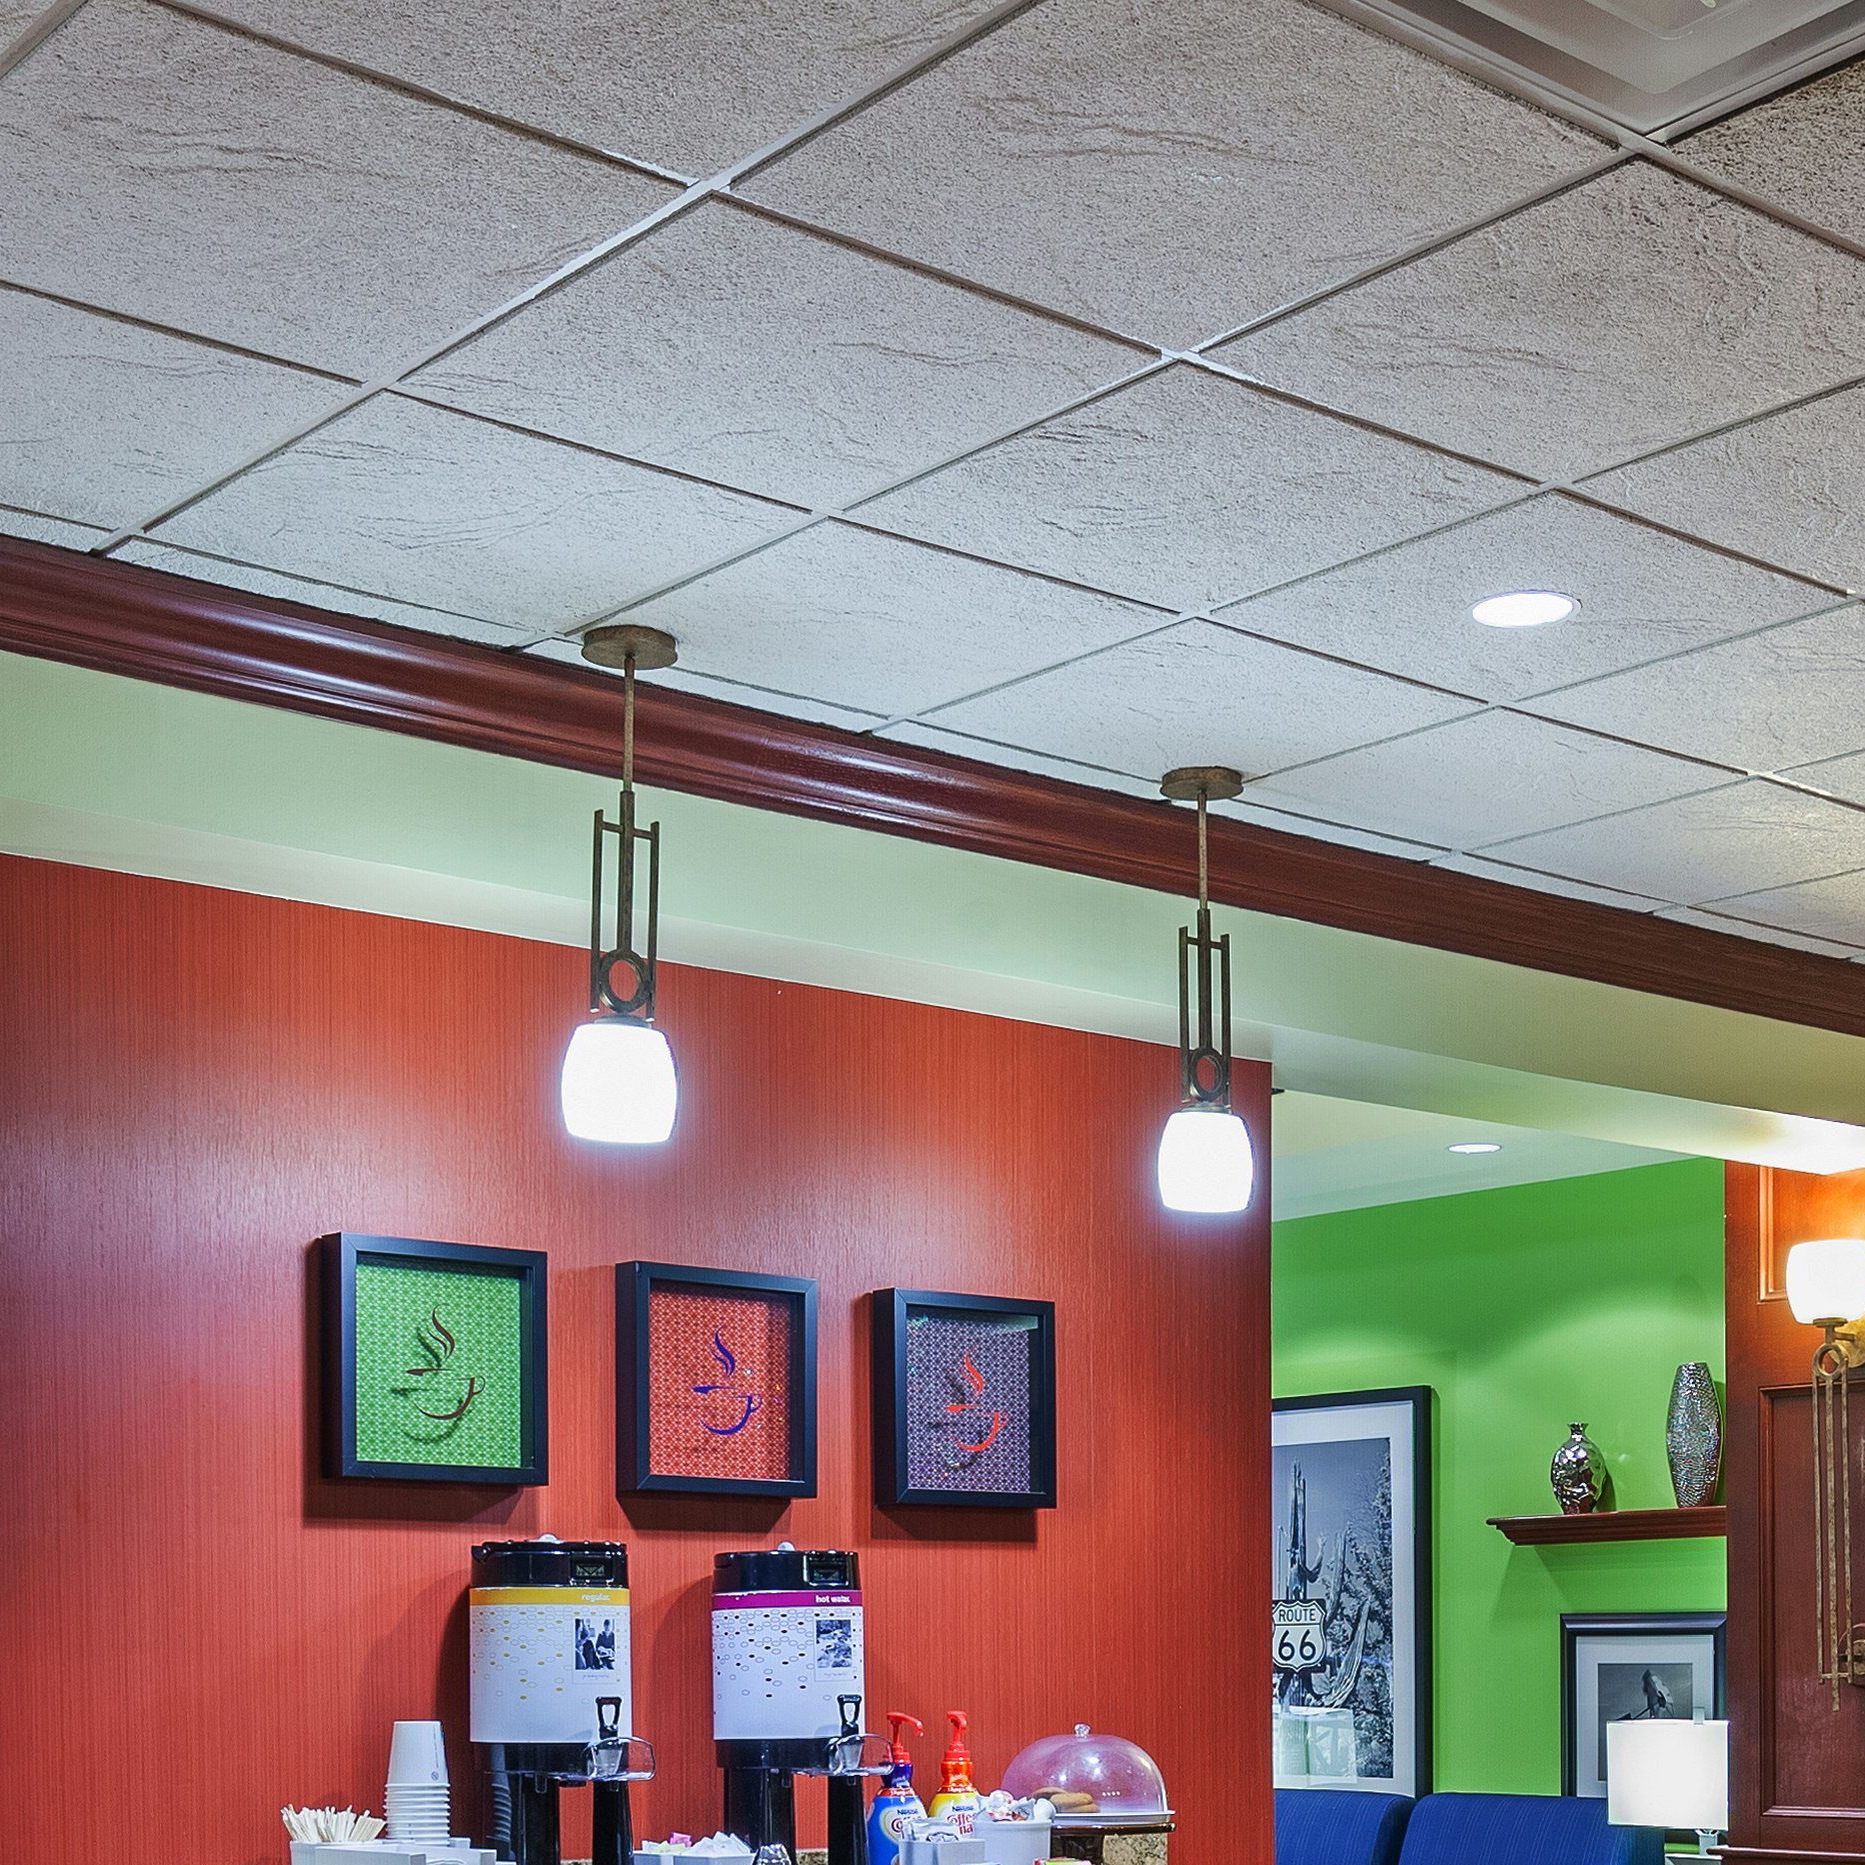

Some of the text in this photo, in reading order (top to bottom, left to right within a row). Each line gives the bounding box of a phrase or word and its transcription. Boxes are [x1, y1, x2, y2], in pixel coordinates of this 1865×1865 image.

[815, 1595, 830, 1603] hot
[1278, 1608, 1316, 1622] ROUTE
[1278, 1629, 1316, 1662] 66
